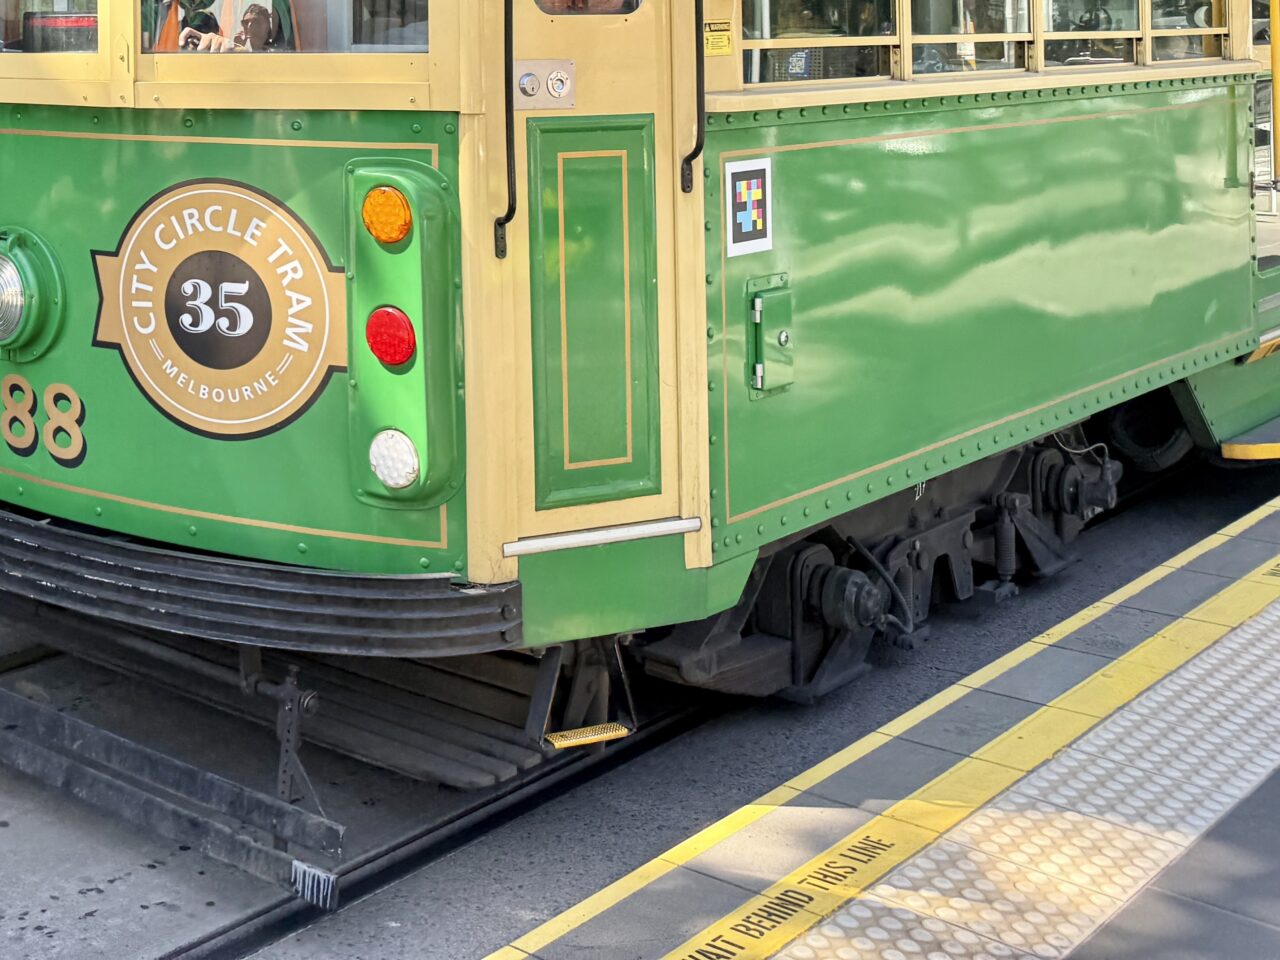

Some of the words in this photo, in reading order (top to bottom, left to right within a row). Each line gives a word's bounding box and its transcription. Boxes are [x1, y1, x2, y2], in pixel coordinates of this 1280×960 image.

[129, 249, 159, 335] CITY
[153, 204, 268, 252] CIRCLE
[265, 237, 315, 353] TRAM
[178, 278, 255, 337] 35
[161, 358, 280, 404] MELBOURNE
[730, 888, 815, 940] BEHIND
[797, 860, 858, 892] THIS
[840, 834, 896, 865] LINE
